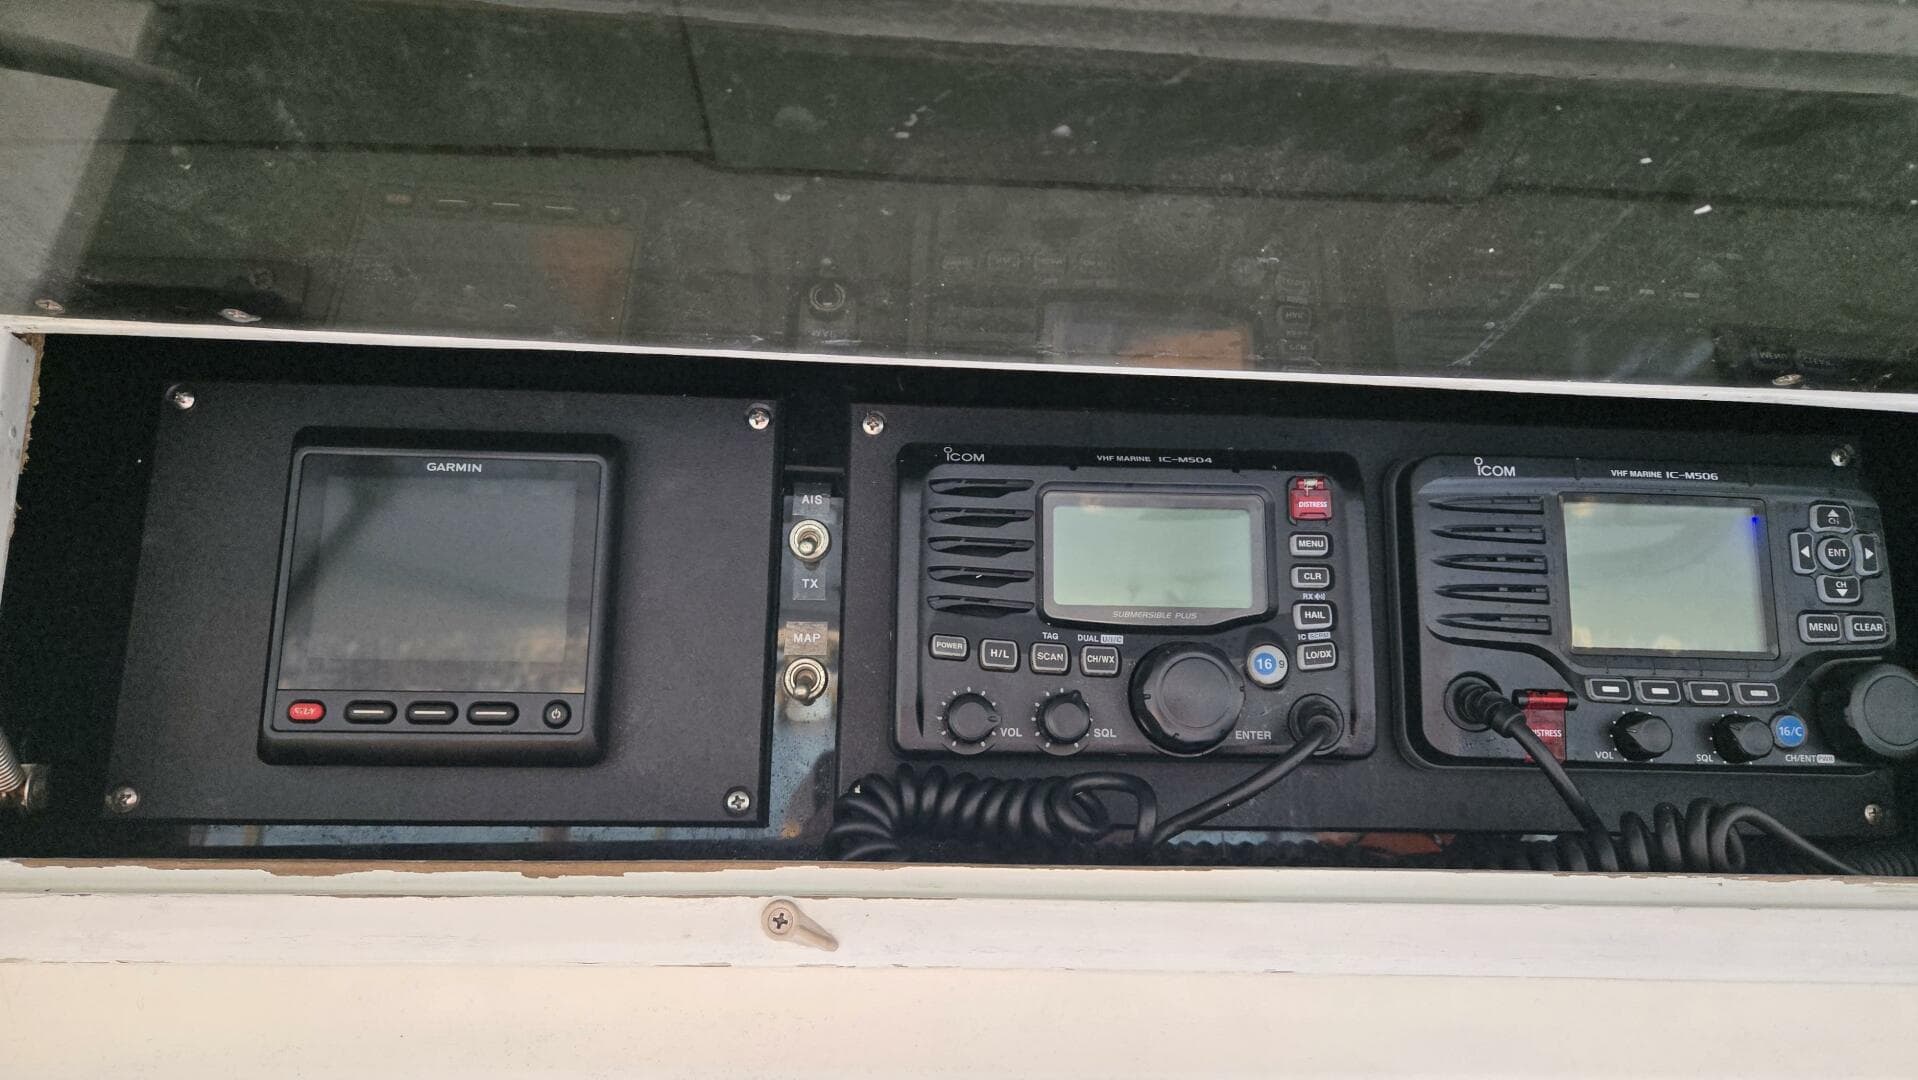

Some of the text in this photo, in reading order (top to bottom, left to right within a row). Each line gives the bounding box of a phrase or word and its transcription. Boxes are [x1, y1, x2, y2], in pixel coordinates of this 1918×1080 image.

[1096, 454, 1212, 464] VHF MARINE IC-M504
[426, 462, 482, 473] GARMIN
[1610, 469, 1719, 481] VHF MARINE IC-M506
[801, 494, 824, 505] AIS
[1298, 539, 1324, 548] MENU
[1827, 547, 1847, 558] ENT
[1303, 573, 1322, 581] CLR
[802, 578, 819, 589] TX
[1835, 580, 1847, 589] CH
[1302, 592, 1313, 600] RX
[1112, 610, 1198, 620] SUBMERSIBLE PLUS
[1304, 610, 1327, 620] HAIL
[1808, 622, 1838, 632] MENU
[1853, 622, 1884, 632] CLEAR
[793, 632, 821, 644] MAP
[1042, 632, 1059, 640] TAG
[1077, 633, 1099, 643] DUAL
[936, 641, 963, 650] POWER
[990, 648, 1010, 659] H/L
[1037, 652, 1064, 662] SCAN
[1305, 650, 1332, 660] LO/DX
[1087, 654, 1115, 664] CH/WX
[1257, 658, 1273, 670] 16
[1000, 727, 1023, 738] VOL
[1093, 729, 1117, 739] SQL
[1235, 730, 1272, 740] ENTER
[1778, 726, 1803, 737] 16/C
[1595, 750, 1614, 760] VOL
[1696, 753, 1714, 763] SQL
[1785, 754, 1816, 763] CH/ENT
